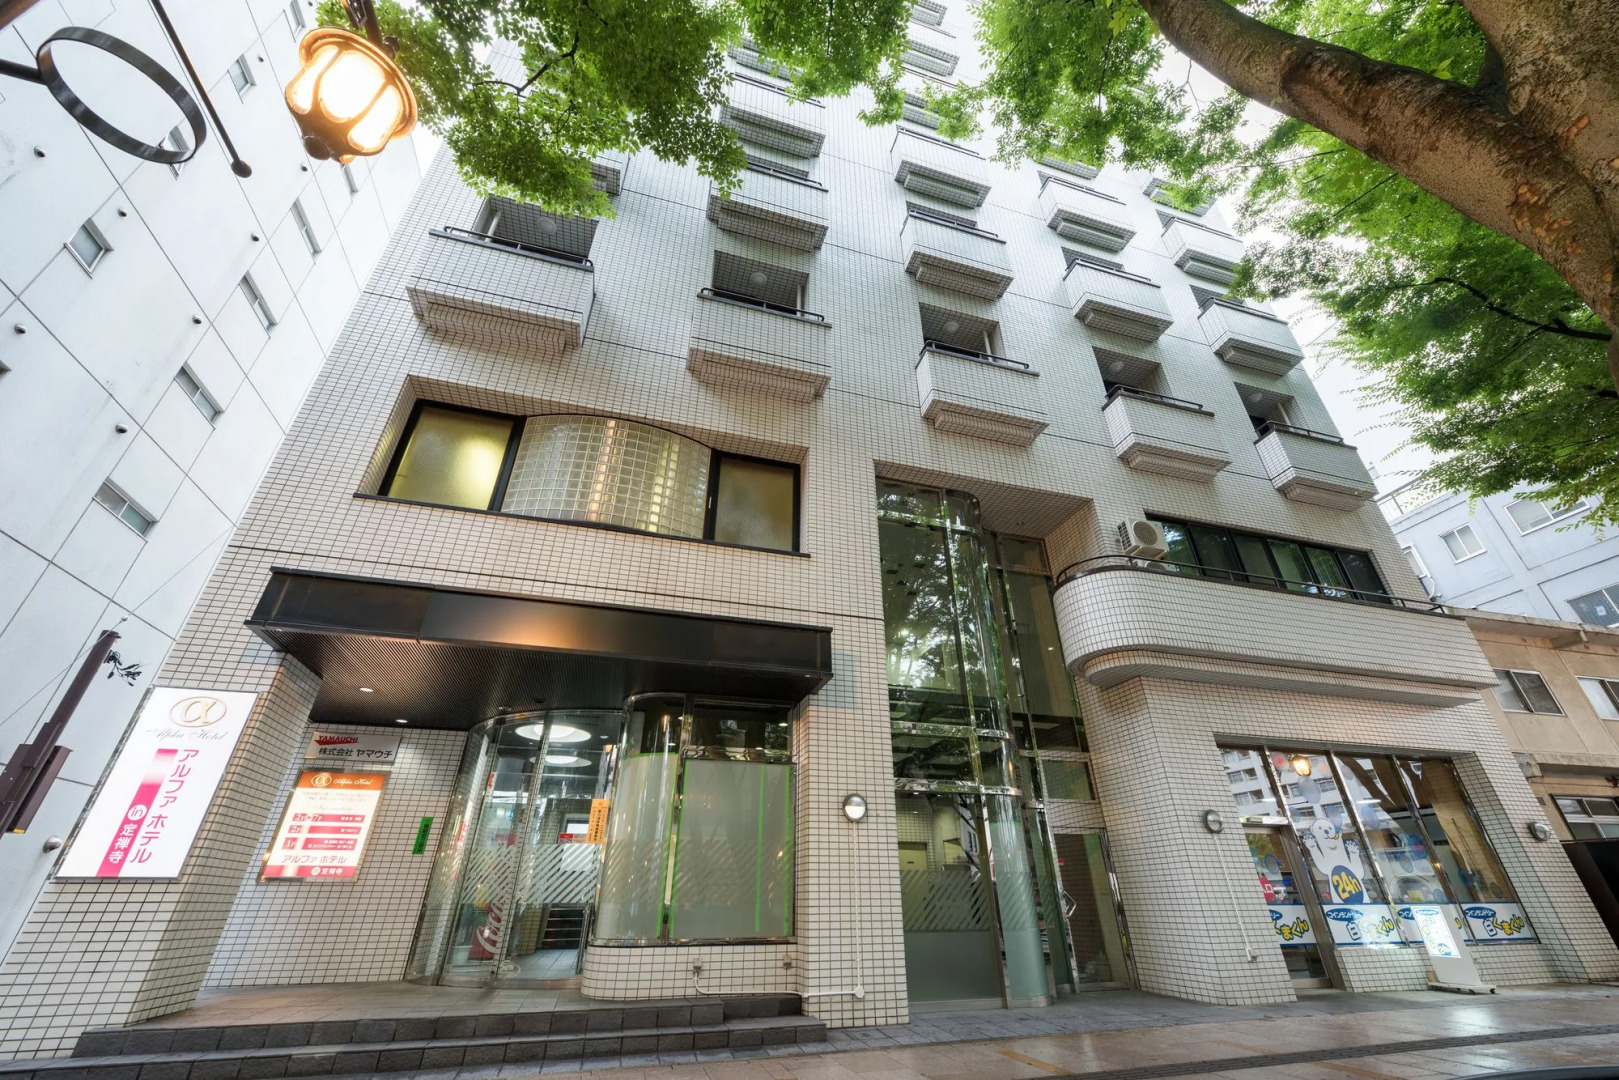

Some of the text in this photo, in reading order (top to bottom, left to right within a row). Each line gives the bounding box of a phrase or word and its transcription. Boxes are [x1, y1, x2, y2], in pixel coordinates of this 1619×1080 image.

[318, 735, 359, 744] YAMAUCHI
[318, 747, 393, 759] 株式会社 ヤマウチ
[131, 806, 144, 817] in
[130, 813, 168, 863] ホテル
[320, 856, 347, 864] ホテル
[1332, 871, 1362, 900] 24h
[1482, 913, 1525, 937] 白くまくん
